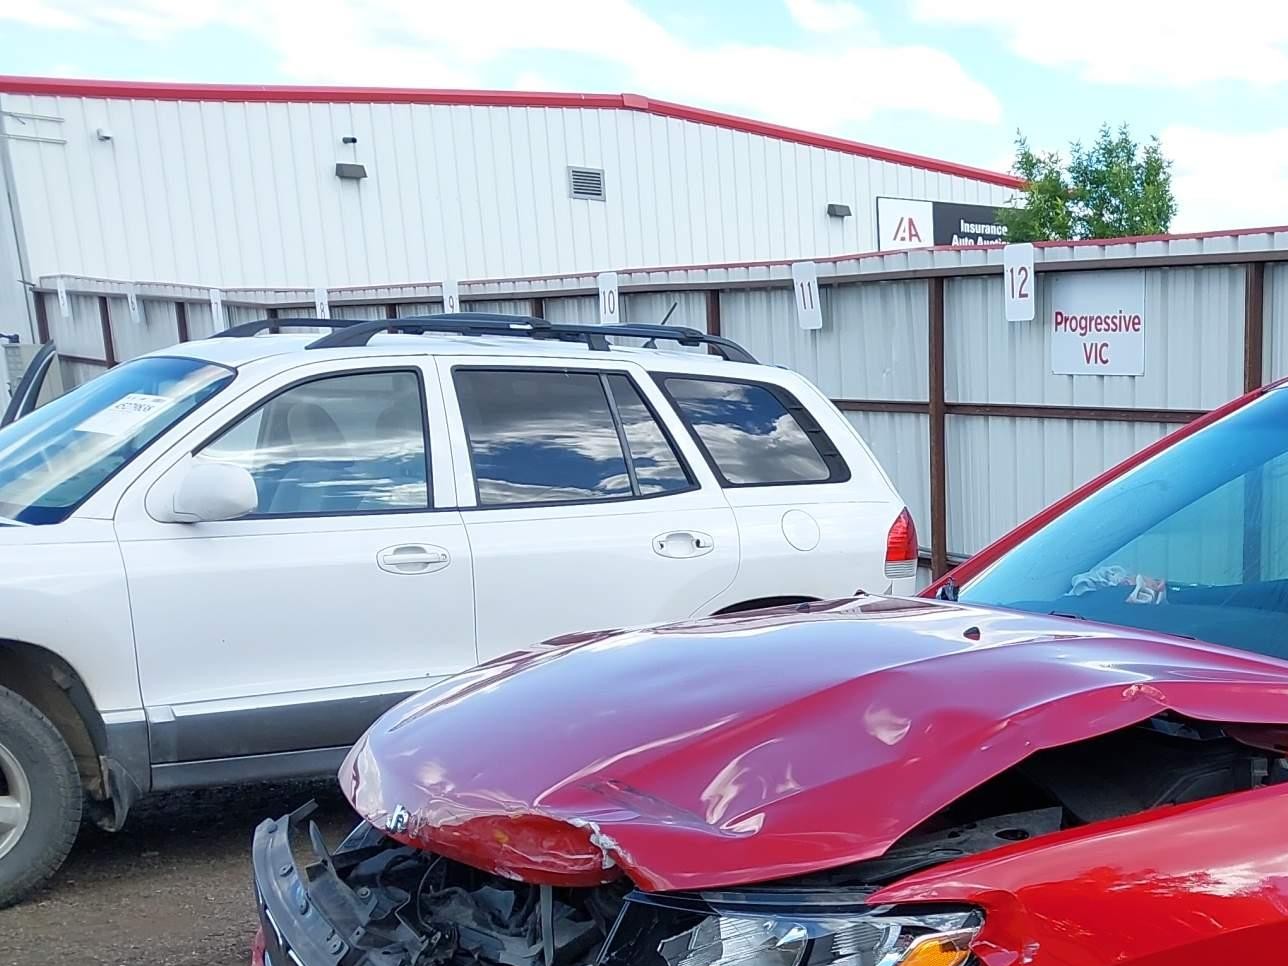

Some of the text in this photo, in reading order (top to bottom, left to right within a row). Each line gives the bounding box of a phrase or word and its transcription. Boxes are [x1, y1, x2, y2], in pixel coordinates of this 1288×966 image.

[960, 218, 1008, 236] Insurance
[799, 281, 816, 312] 11
[1008, 266, 1030, 300] 12
[602, 288, 616, 315] 10
[1054, 310, 1142, 337] Progressive
[1082, 342, 1110, 365] VIC
